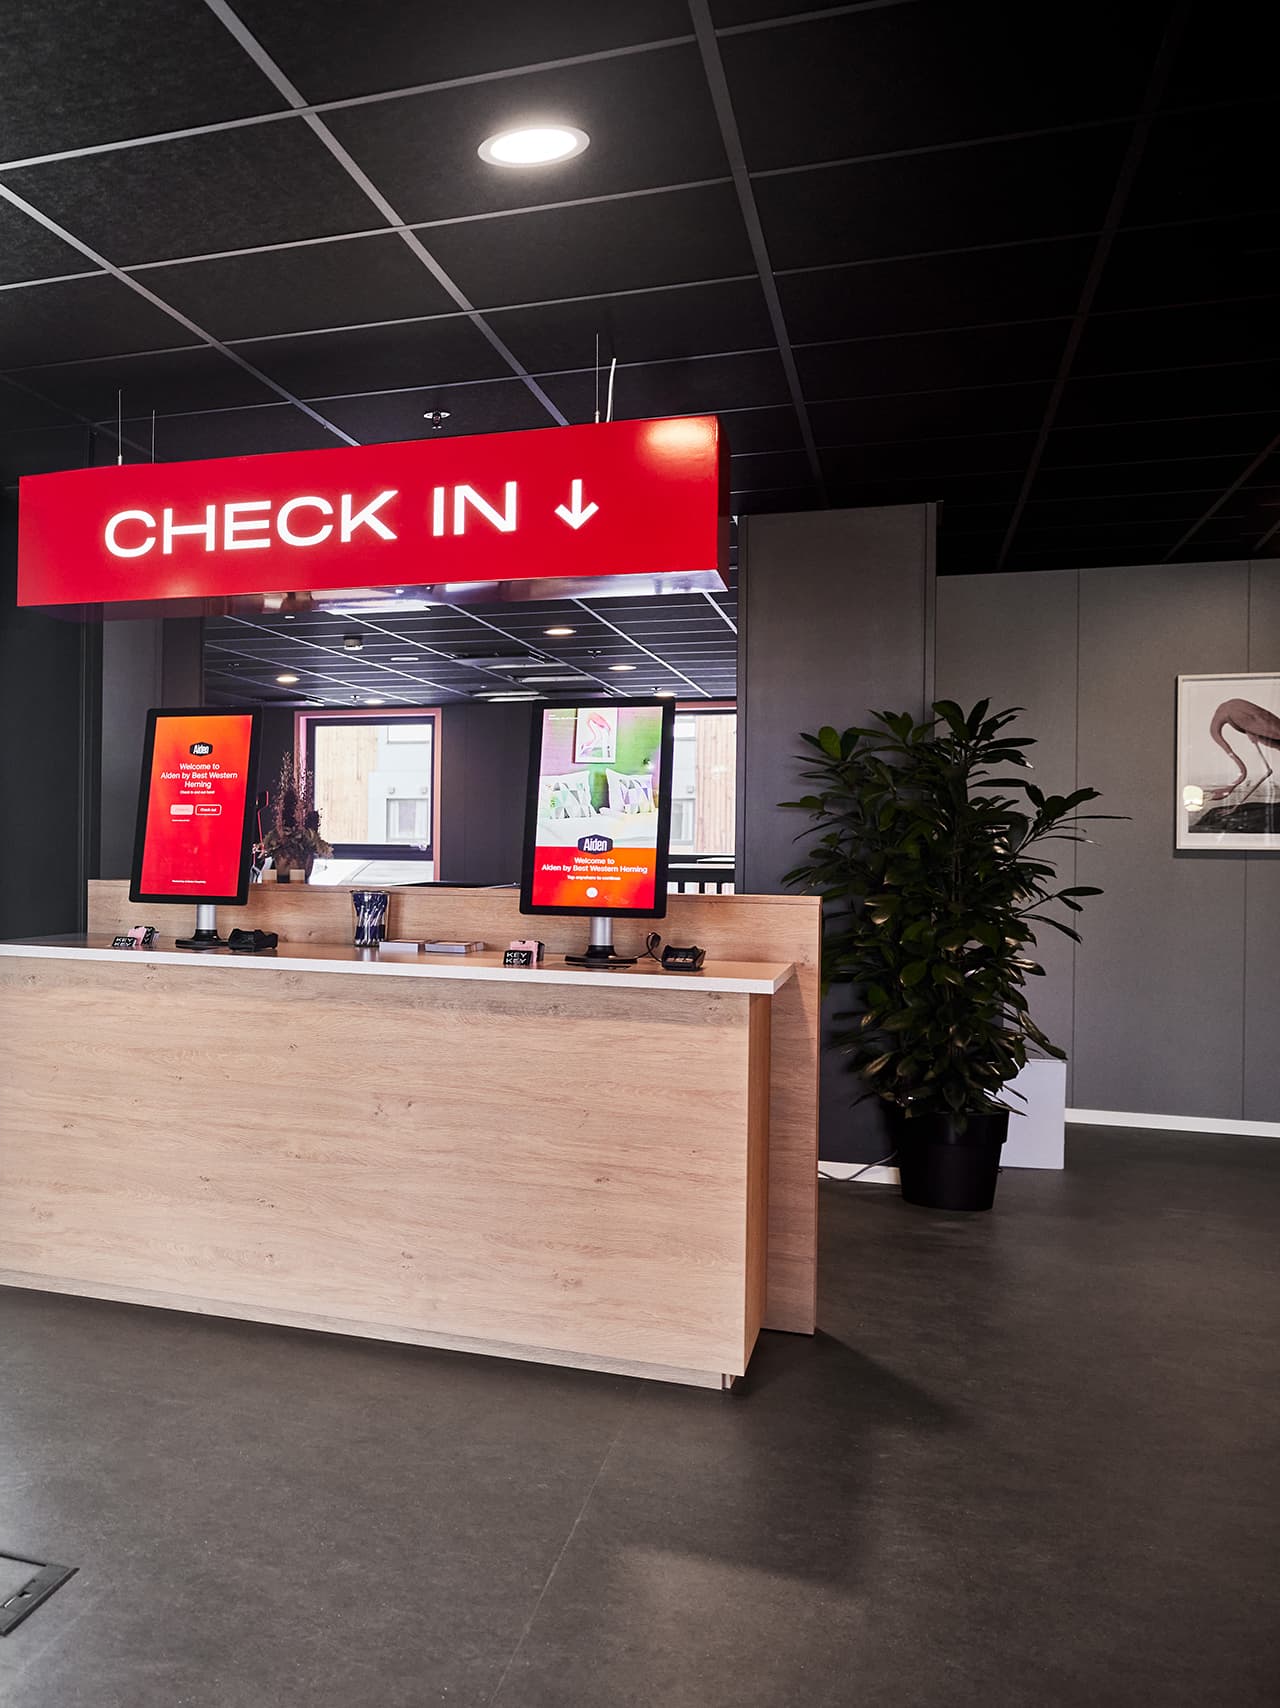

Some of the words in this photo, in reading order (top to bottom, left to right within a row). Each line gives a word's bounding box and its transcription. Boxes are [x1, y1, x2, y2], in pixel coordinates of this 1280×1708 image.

[104, 489, 398, 557] CHECK
[432, 481, 517, 536] IN
[181, 772, 190, 780] by
[184, 781, 212, 790] Herning
[583, 838, 608, 851] Aiden
[574, 857, 606, 865] Welcome
[562, 864, 572, 873] by
[572, 864, 588, 872] Best
[590, 865, 619, 873] Western
[620, 866, 648, 875] Herning
